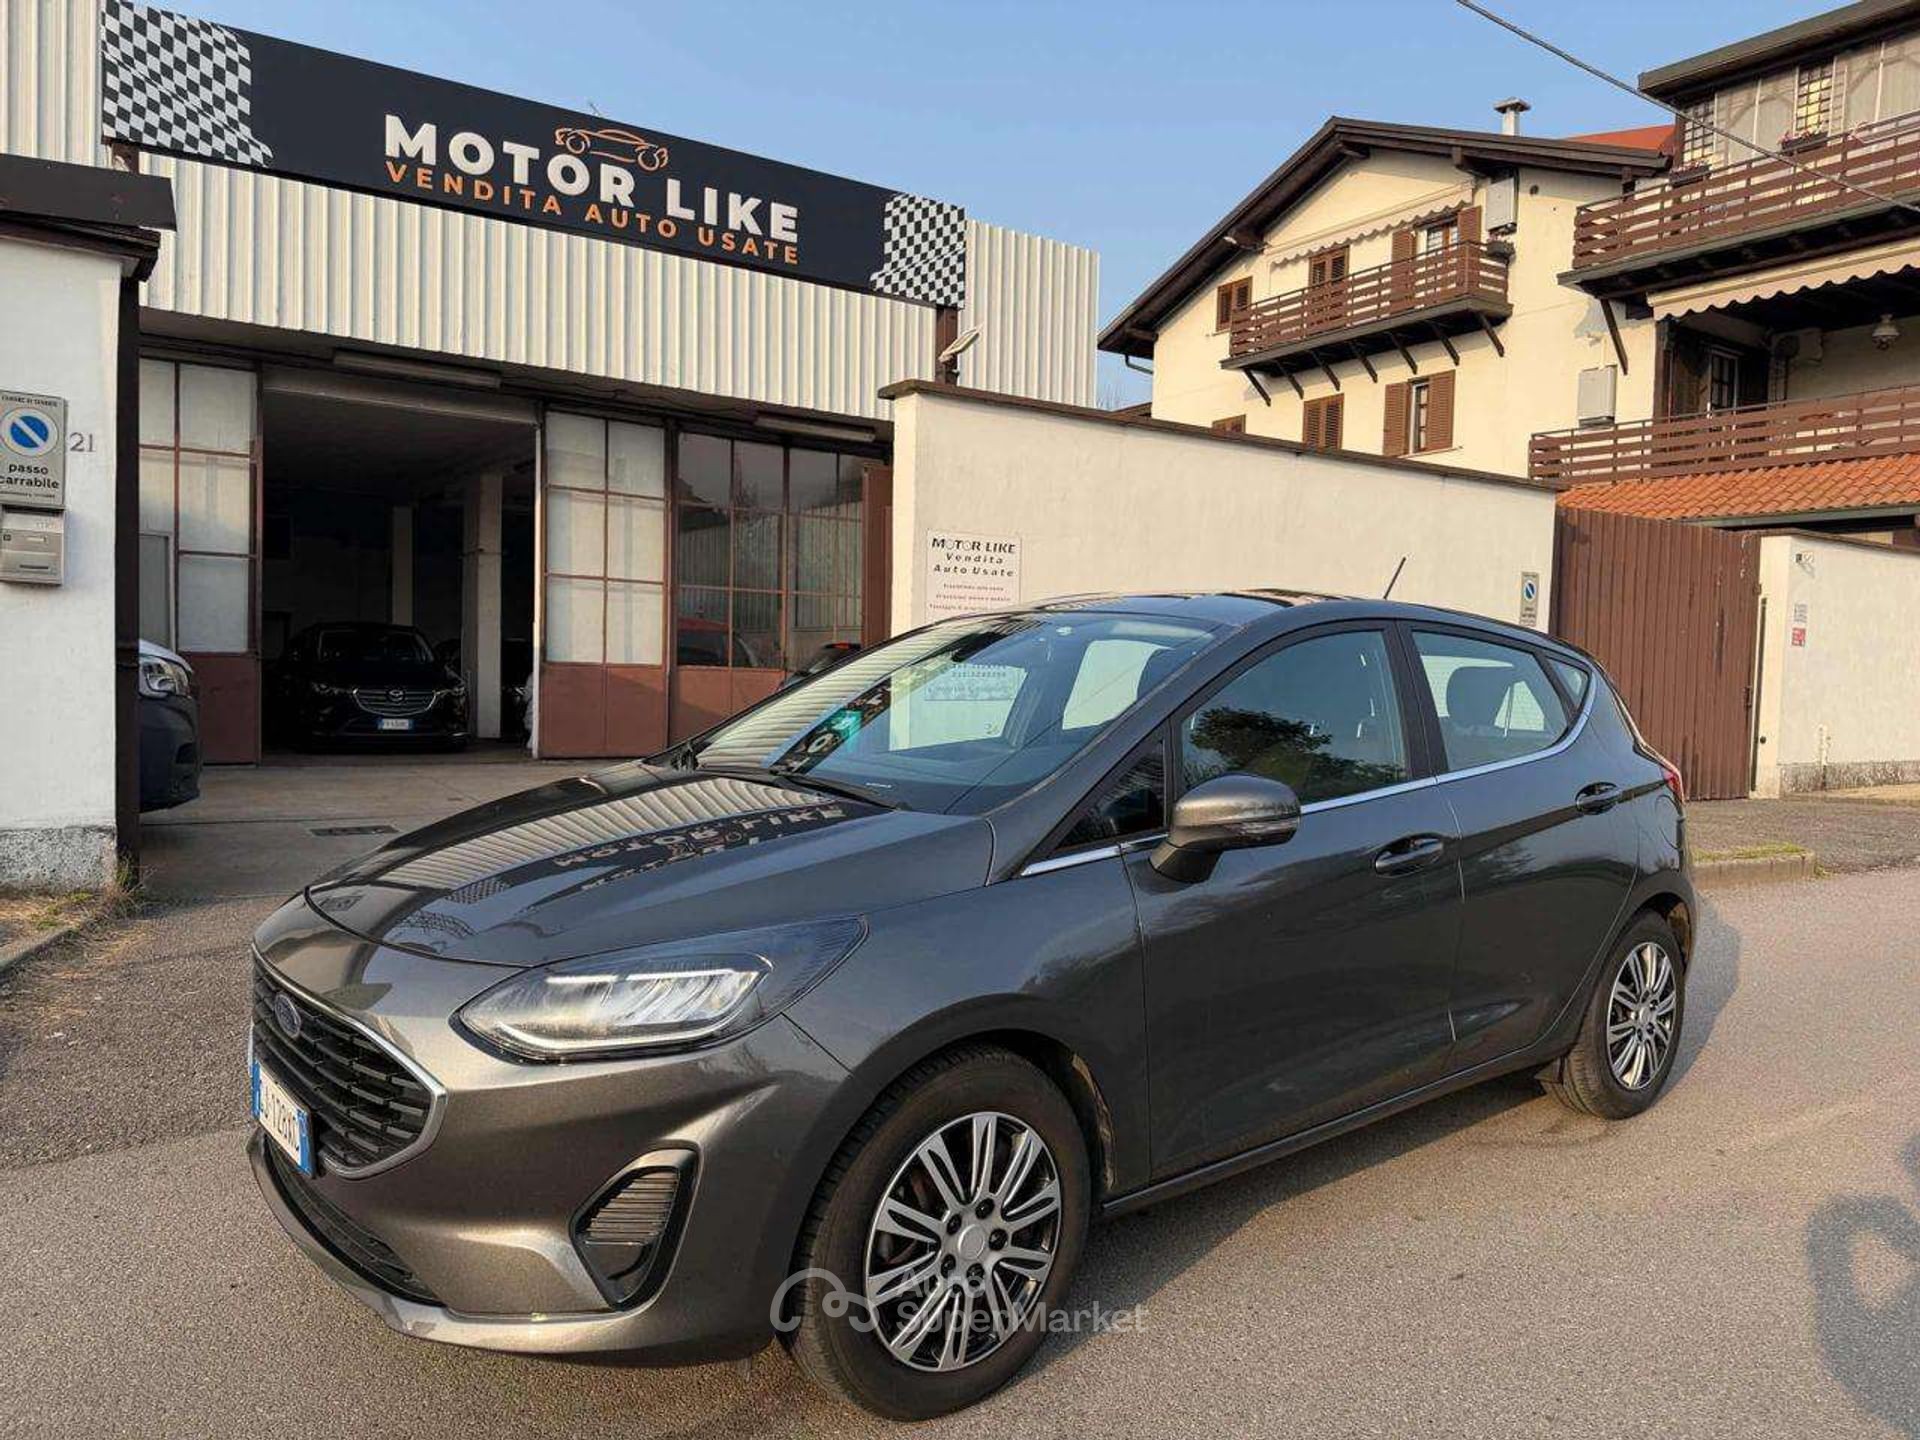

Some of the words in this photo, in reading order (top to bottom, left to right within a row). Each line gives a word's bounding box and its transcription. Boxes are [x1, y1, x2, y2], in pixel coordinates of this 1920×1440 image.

[385, 114, 635, 208] MOTOR
[666, 178, 799, 243] LIKE
[384, 161, 563, 216] VENDITA
[585, 204, 677, 238] AUTO
[698, 226, 799, 265] USATE
[69, 432, 93, 452] 21
[9, 463, 48, 475] passo
[932, 537, 981, 551] MOTOR
[985, 541, 1016, 554] LIKE
[946, 552, 1003, 564] Vendita
[934, 564, 967, 574] Auto
[972, 566, 1013, 577] Usate
